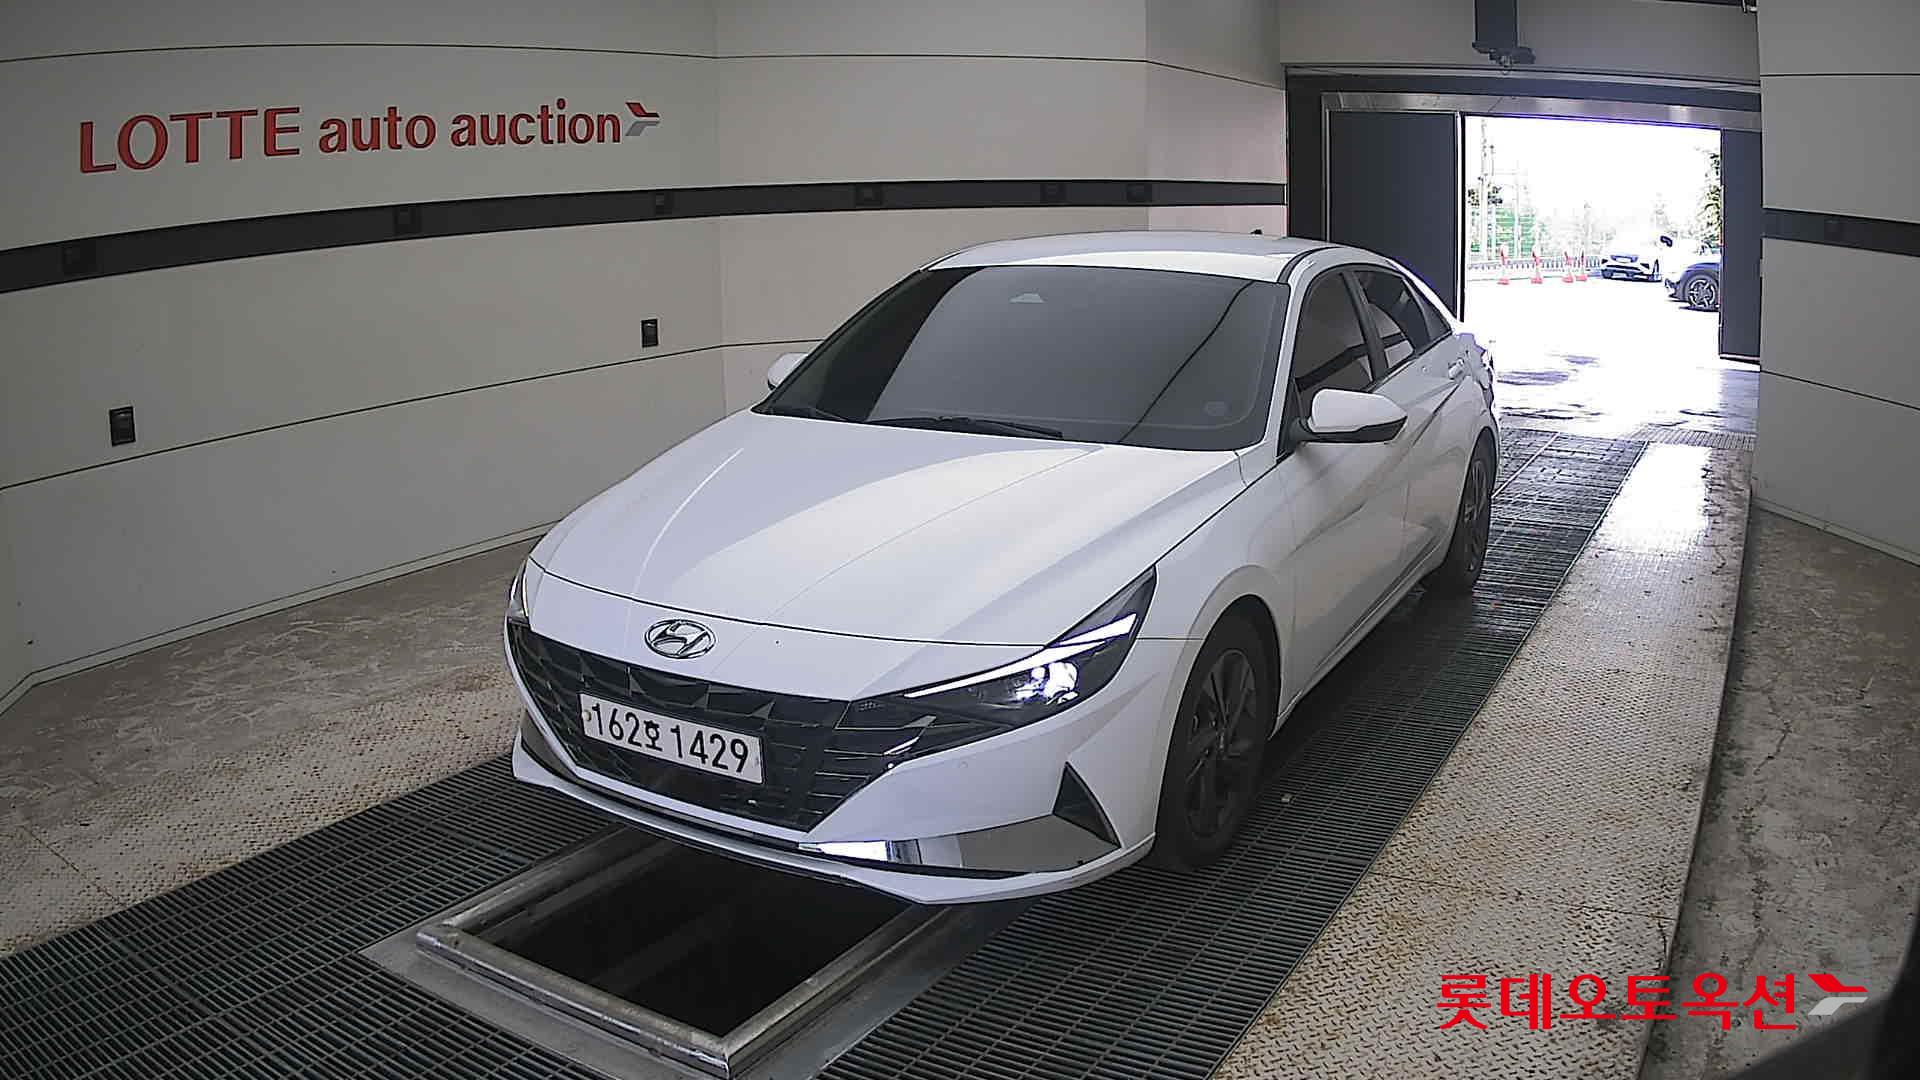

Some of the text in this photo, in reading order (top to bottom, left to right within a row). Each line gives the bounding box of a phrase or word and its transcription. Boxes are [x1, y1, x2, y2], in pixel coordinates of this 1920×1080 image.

[80, 98, 621, 174] LOTTE auto auction
